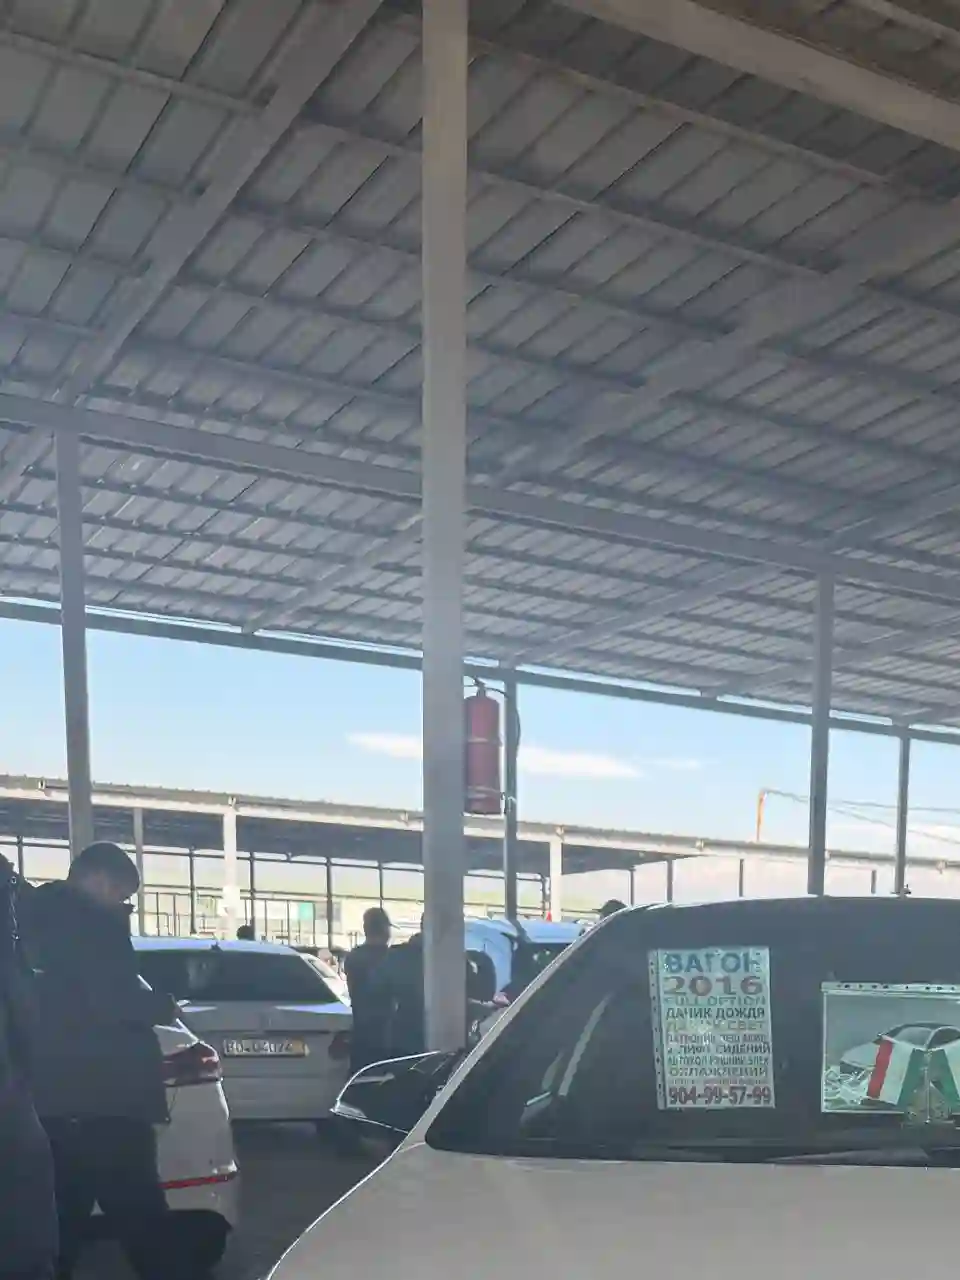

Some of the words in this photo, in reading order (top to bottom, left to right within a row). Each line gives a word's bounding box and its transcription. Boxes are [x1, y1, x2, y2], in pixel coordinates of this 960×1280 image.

[664, 952, 761, 973] ВАГОН
[663, 976, 763, 996] 2016
[666, 1007, 713, 1020] ДАЧИК
[715, 1007, 765, 1020] ДОЖДЯ
